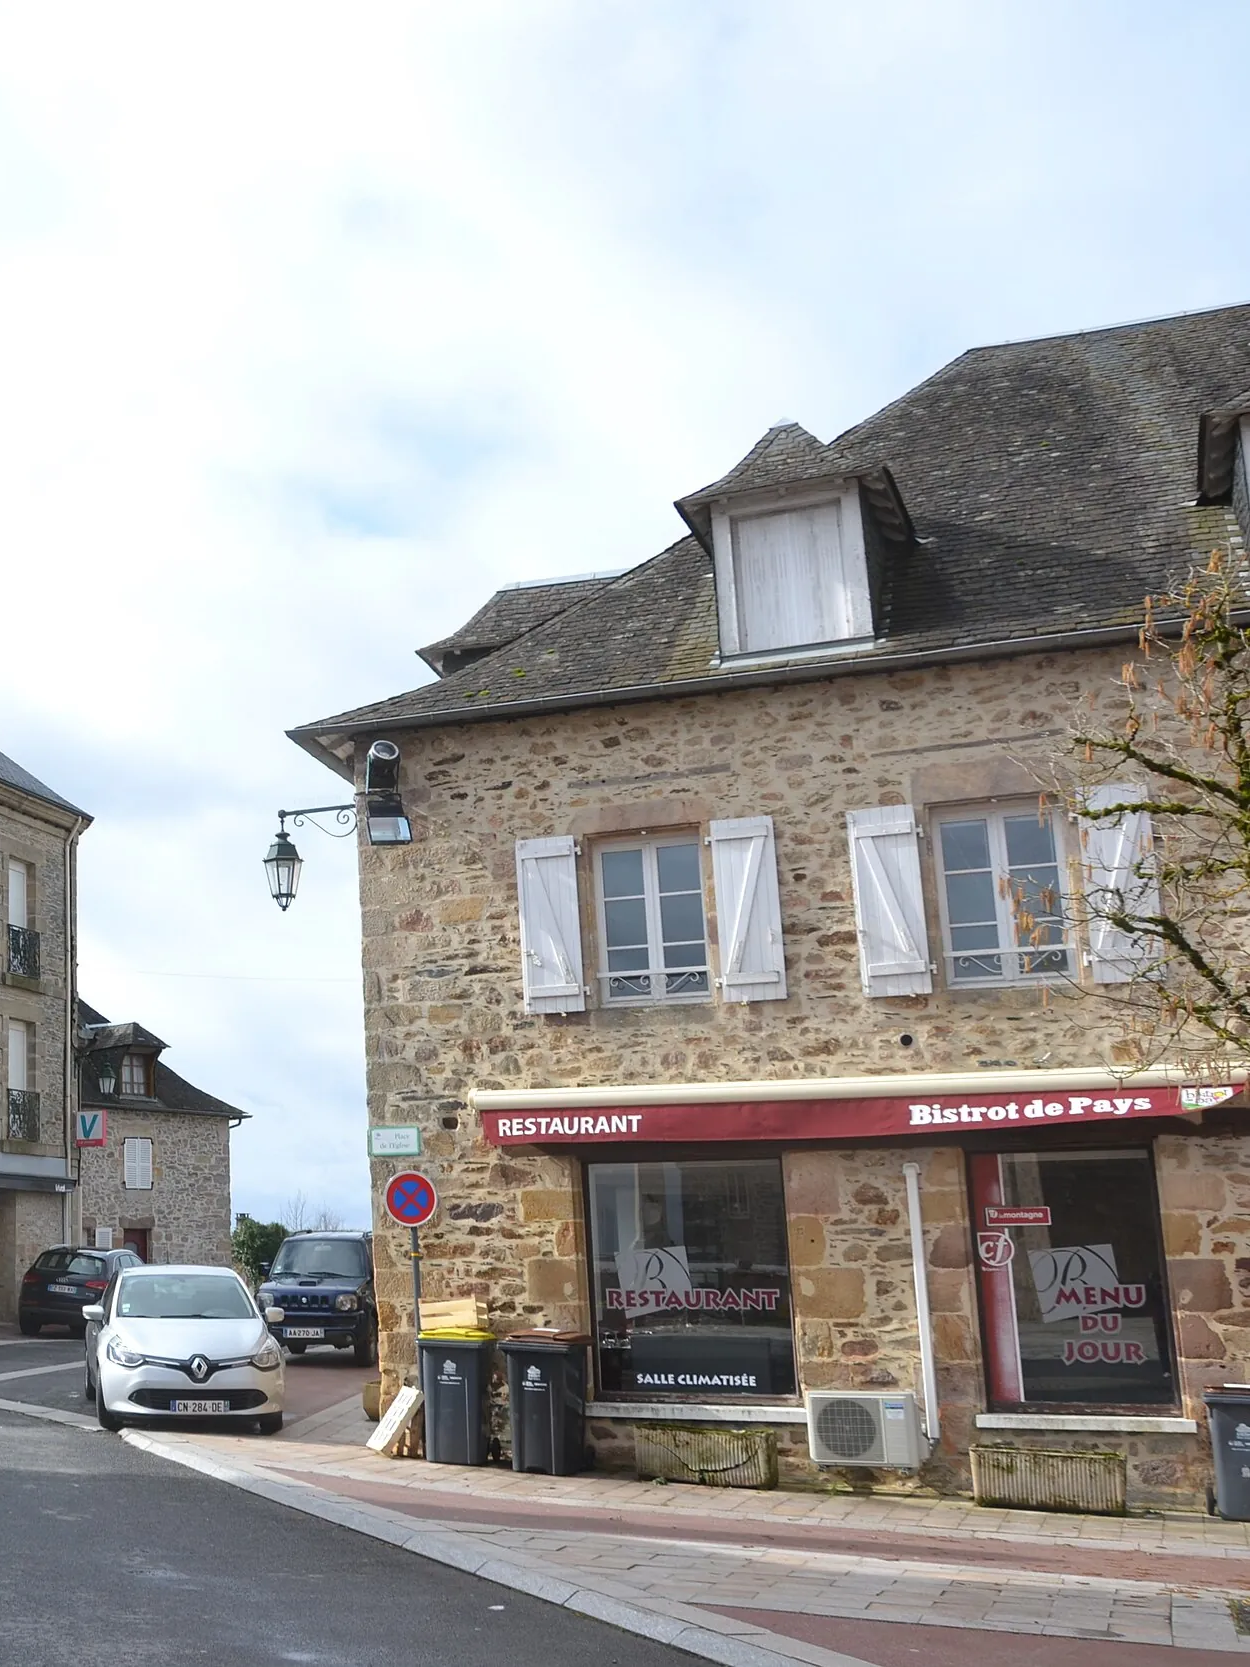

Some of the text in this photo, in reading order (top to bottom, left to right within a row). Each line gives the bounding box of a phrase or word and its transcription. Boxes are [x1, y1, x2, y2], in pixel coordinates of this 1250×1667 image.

[908, 1096, 1152, 1126] Bistrot de Pays
[80, 1114, 99, 1139] V
[497, 1114, 643, 1137] RESTAURANT
[1003, 1211, 1044, 1220] montagne
[606, 1288, 779, 1311] RESTAURANT
[1055, 1285, 1145, 1308] MENU
[1080, 1314, 1121, 1334] DU
[1062, 1340, 1147, 1365] JOUR
[636, 1372, 757, 1387] SALLE CLIMATISÉE
